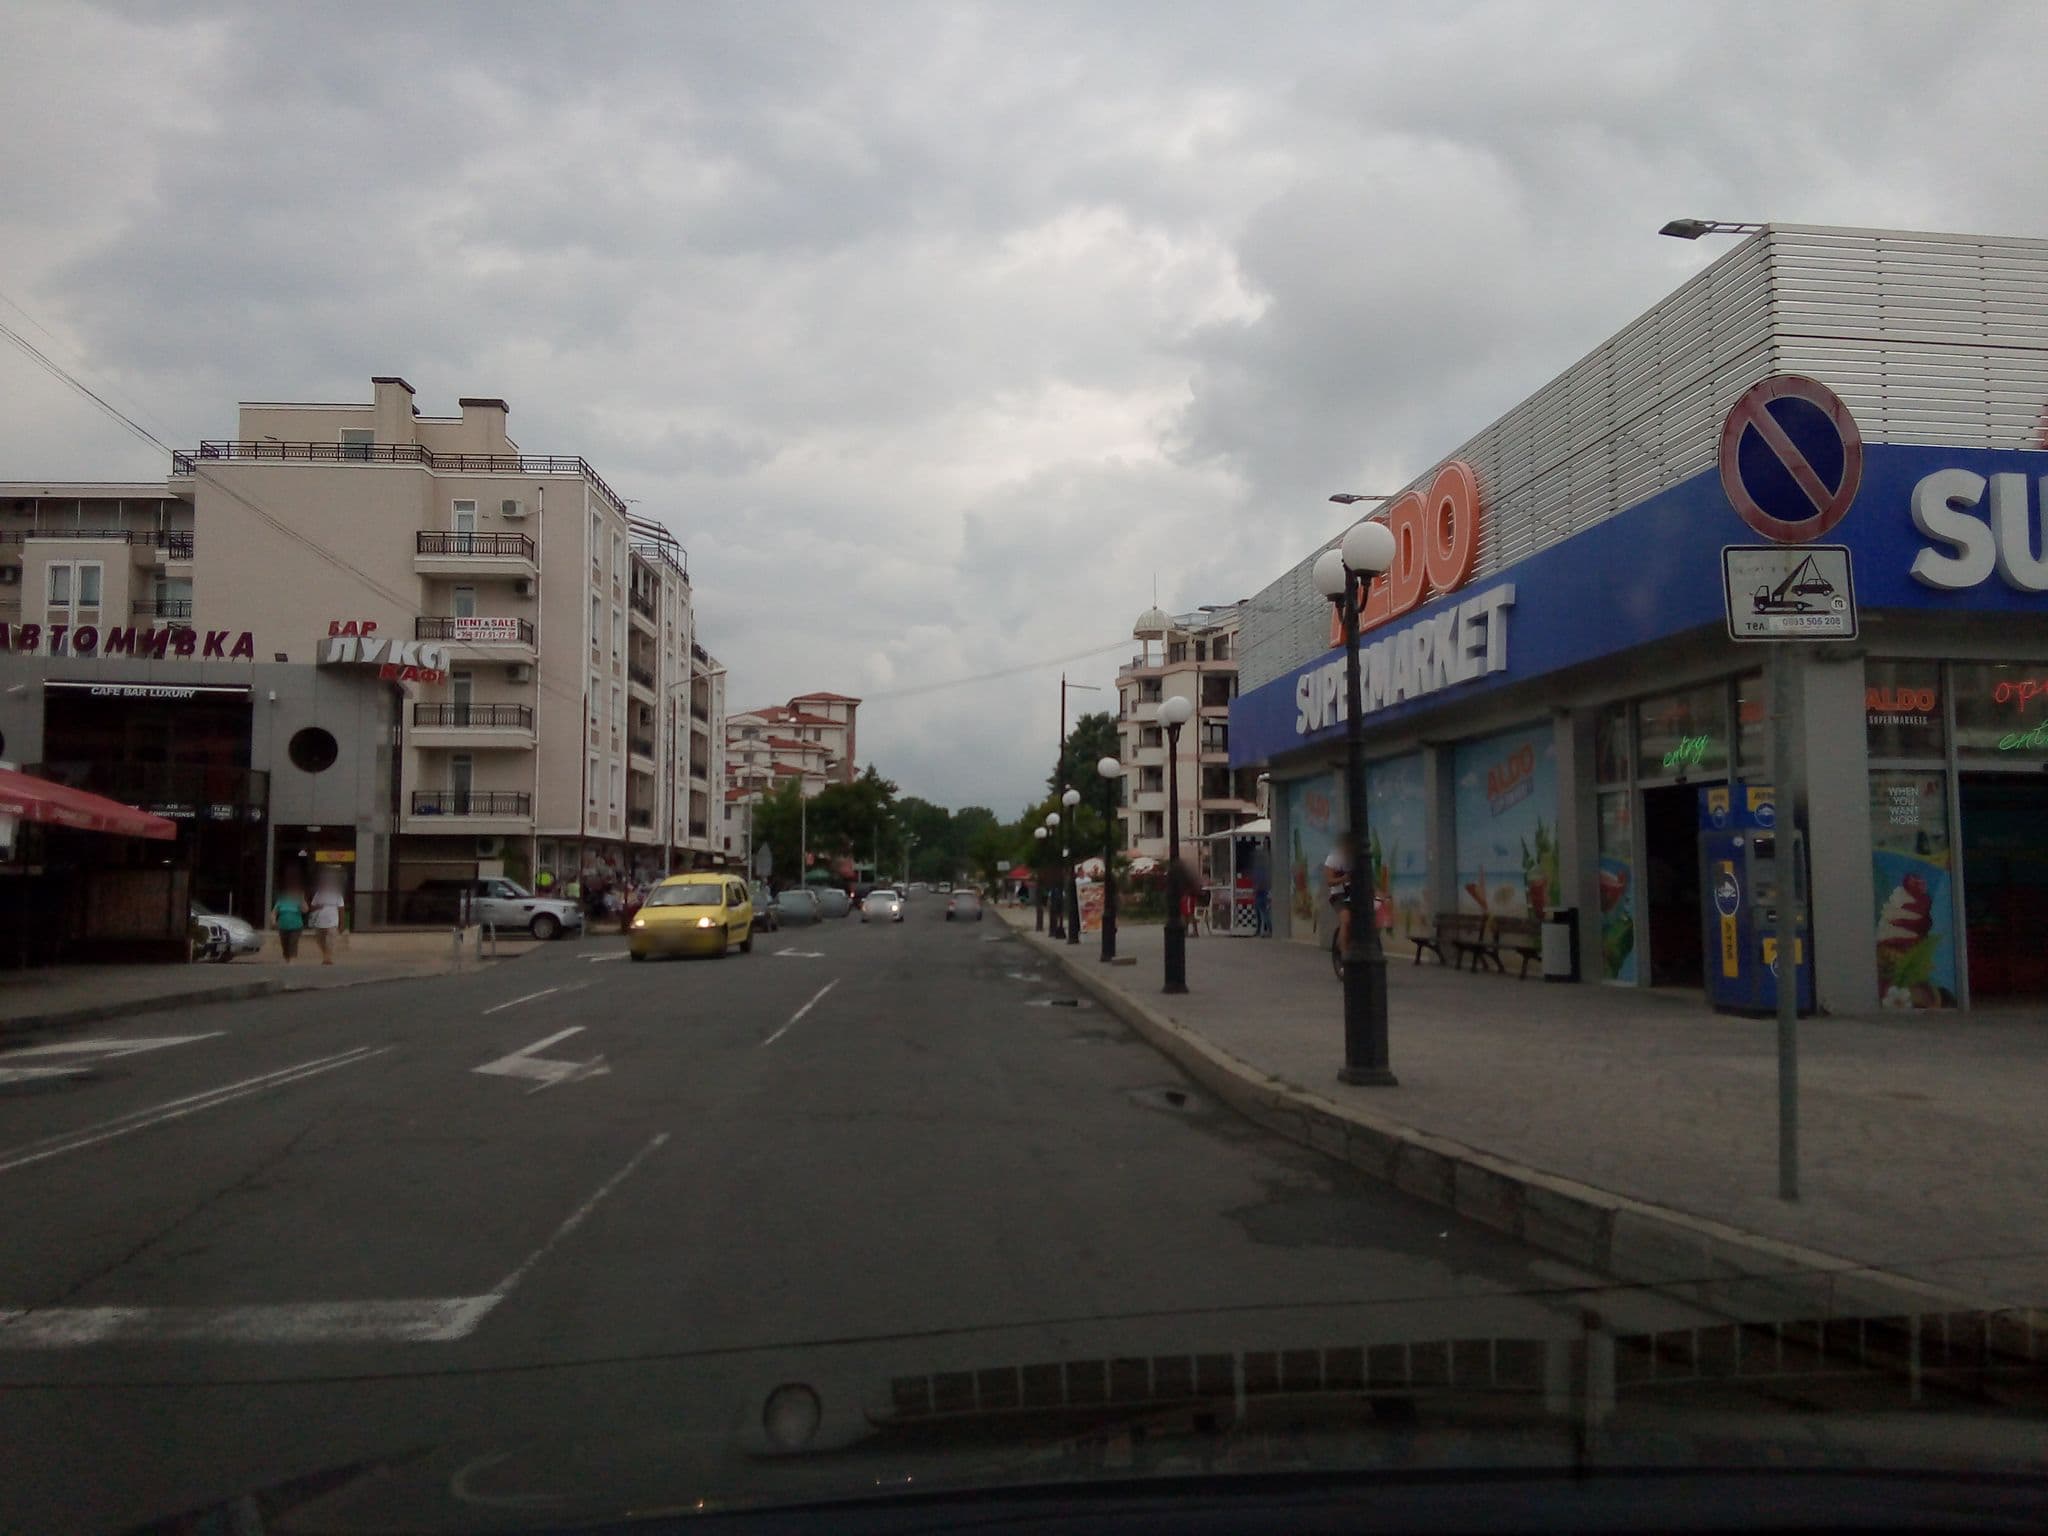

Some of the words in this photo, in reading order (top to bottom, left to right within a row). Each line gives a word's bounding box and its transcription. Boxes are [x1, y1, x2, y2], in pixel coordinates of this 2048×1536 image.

[1329, 460, 1479, 648] LDO
[457, 619, 481, 627] RENT
[491, 619, 516, 627] SALE
[328, 620, 377, 637] БАР
[91, 686, 121, 696] CAFE
[123, 687, 147, 697] BAR
[149, 688, 196, 699] LUXURY
[1865, 687, 1936, 712] ALDO
[1868, 715, 1929, 726] SUPERMARKETS
[1888, 786, 1920, 796] WHEN
[1893, 796, 1915, 805] YOU
[1888, 806, 1920, 816] WANT
[1889, 815, 1920, 825] MORE
